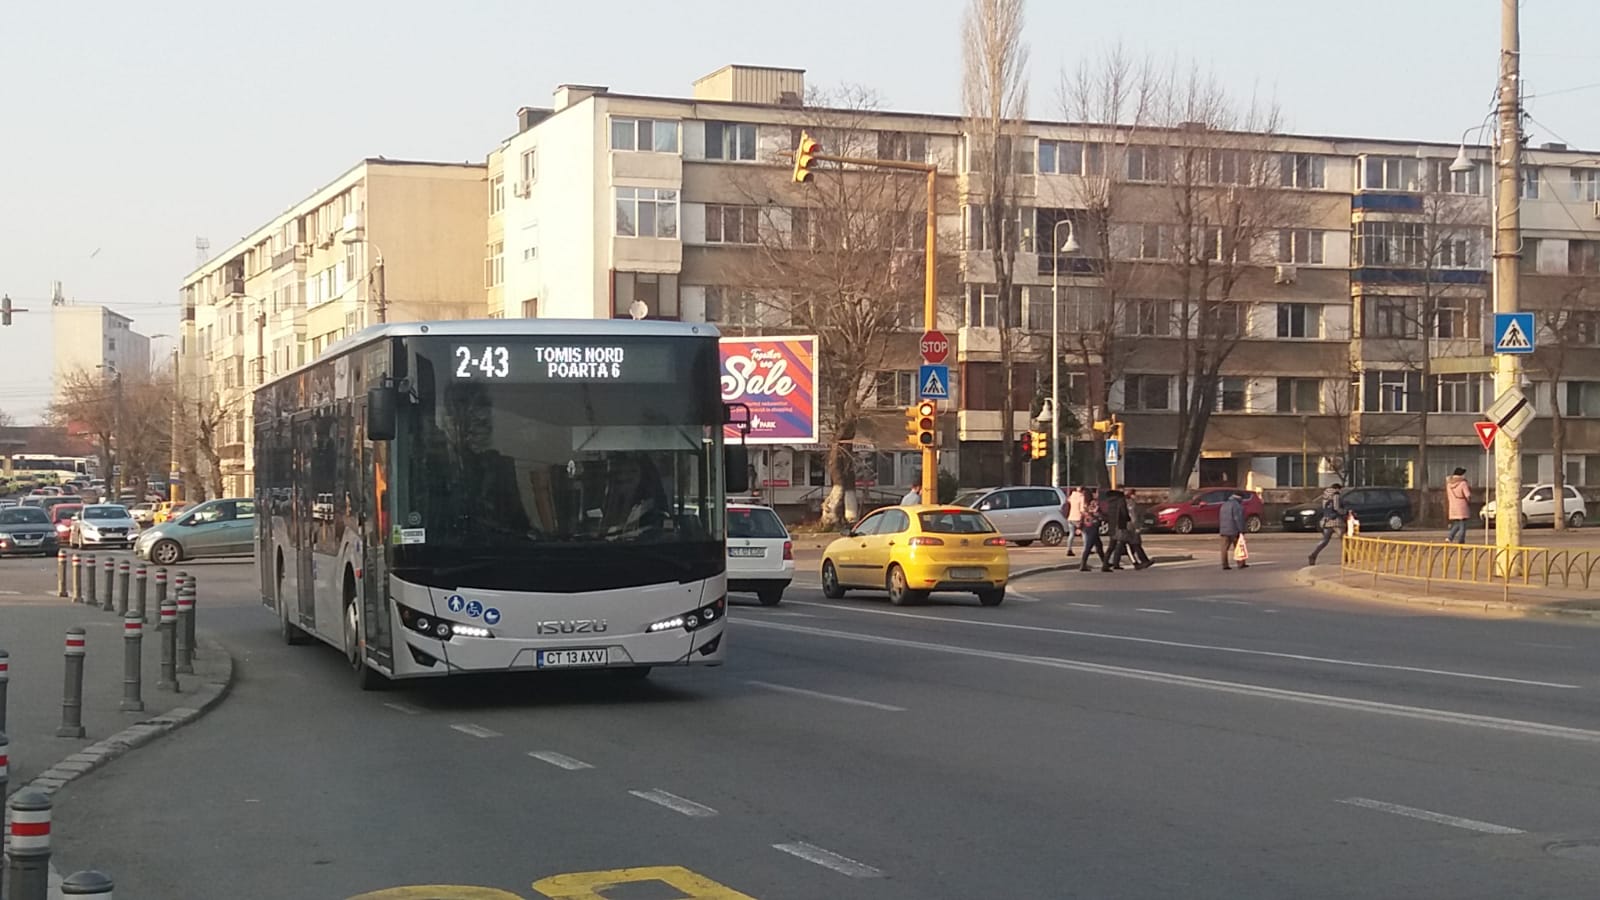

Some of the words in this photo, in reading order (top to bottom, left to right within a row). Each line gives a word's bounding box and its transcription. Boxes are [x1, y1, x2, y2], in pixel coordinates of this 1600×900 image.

[535, 347, 582, 362] TOMIS
[585, 347, 624, 362] NORD
[922, 341, 947, 353] STOP
[456, 346, 509, 377] 2-43
[548, 362, 609, 378] POARTA
[611, 362, 621, 378] 6
[720, 355, 797, 400] Sale
[759, 421, 776, 429] PARK
[537, 618, 607, 635] ISUZU
[546, 652, 562, 664] CT
[566, 651, 578, 663] 13
[580, 650, 603, 663] AXV
